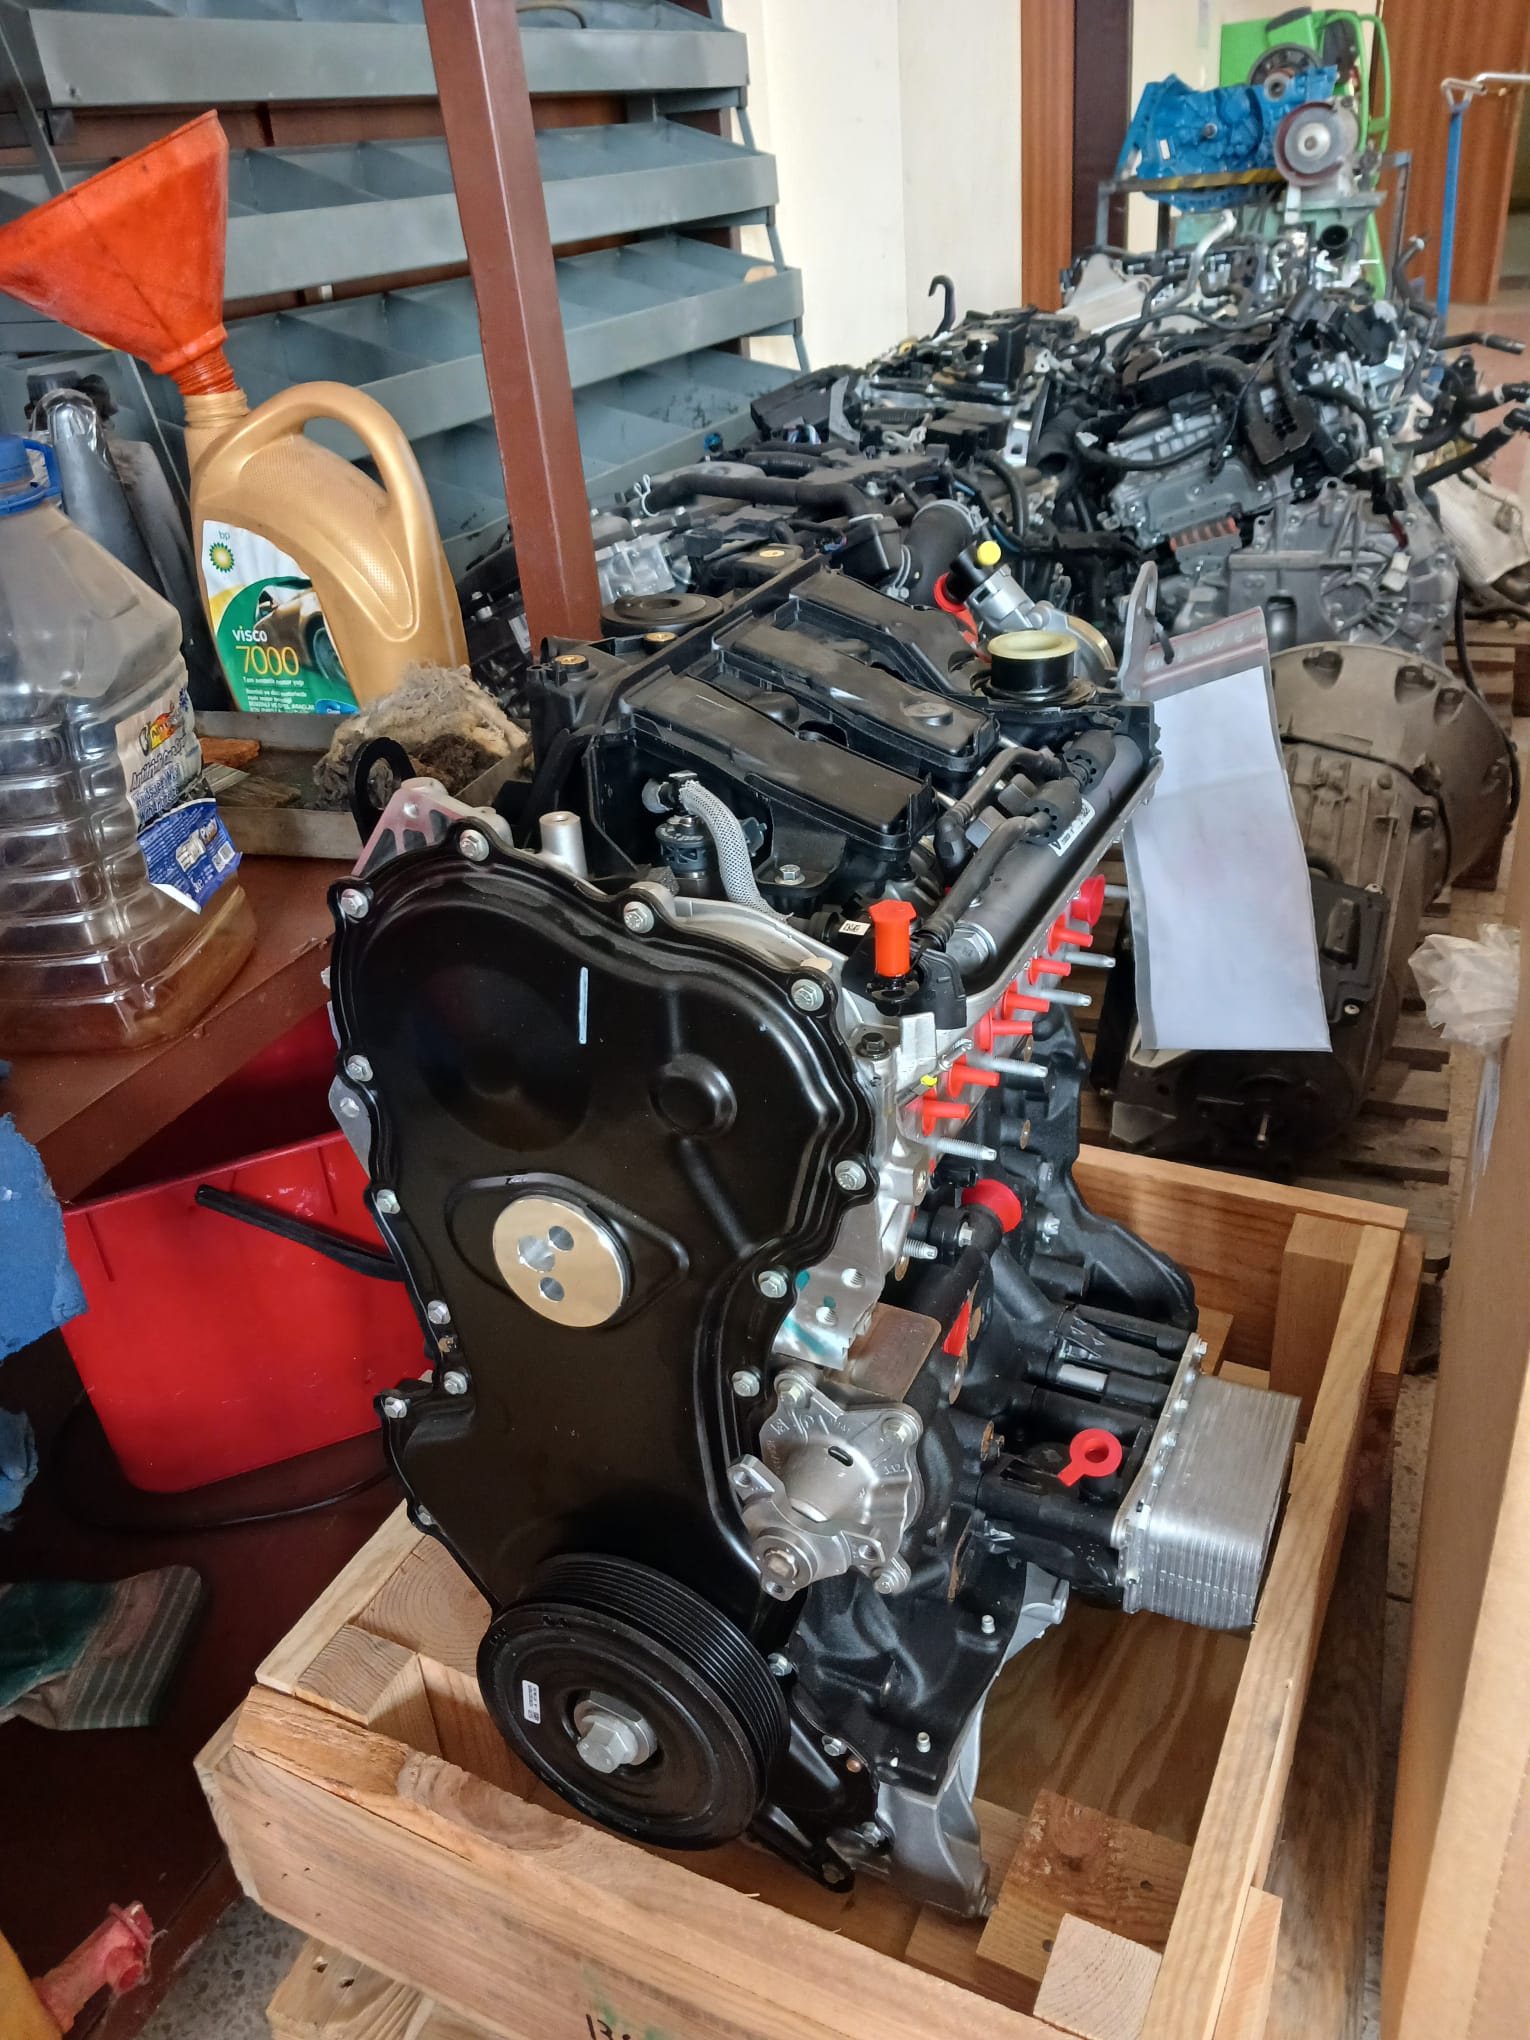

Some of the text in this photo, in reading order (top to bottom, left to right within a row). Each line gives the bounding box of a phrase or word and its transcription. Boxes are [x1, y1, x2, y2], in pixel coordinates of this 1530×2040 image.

[218, 530, 230, 540] bp
[231, 625, 268, 642] visco
[235, 645, 299, 676] 7000
